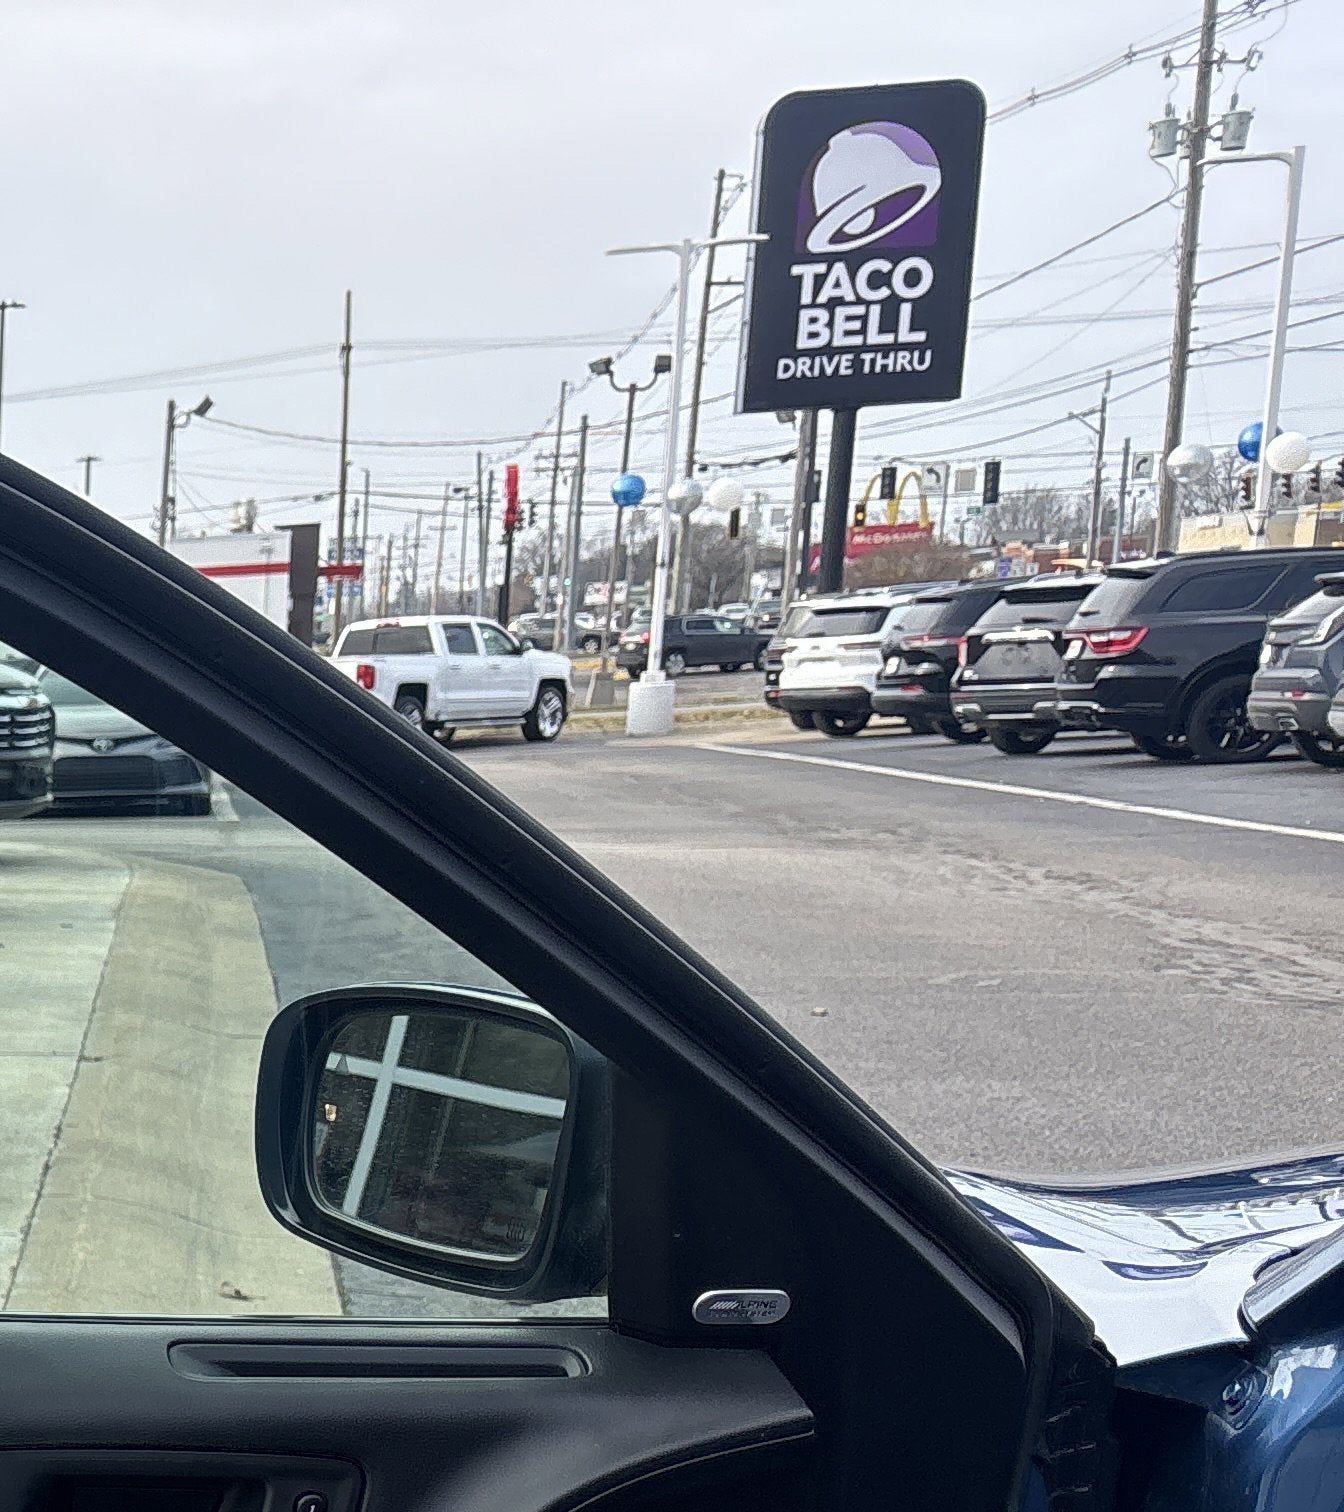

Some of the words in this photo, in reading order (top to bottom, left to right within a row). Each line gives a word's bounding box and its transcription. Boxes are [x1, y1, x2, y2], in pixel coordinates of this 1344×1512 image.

[790, 256, 934, 306] TACO
[795, 301, 927, 350] BELL
[776, 353, 855, 380] DRIVE
[860, 349, 932, 374] THRU
